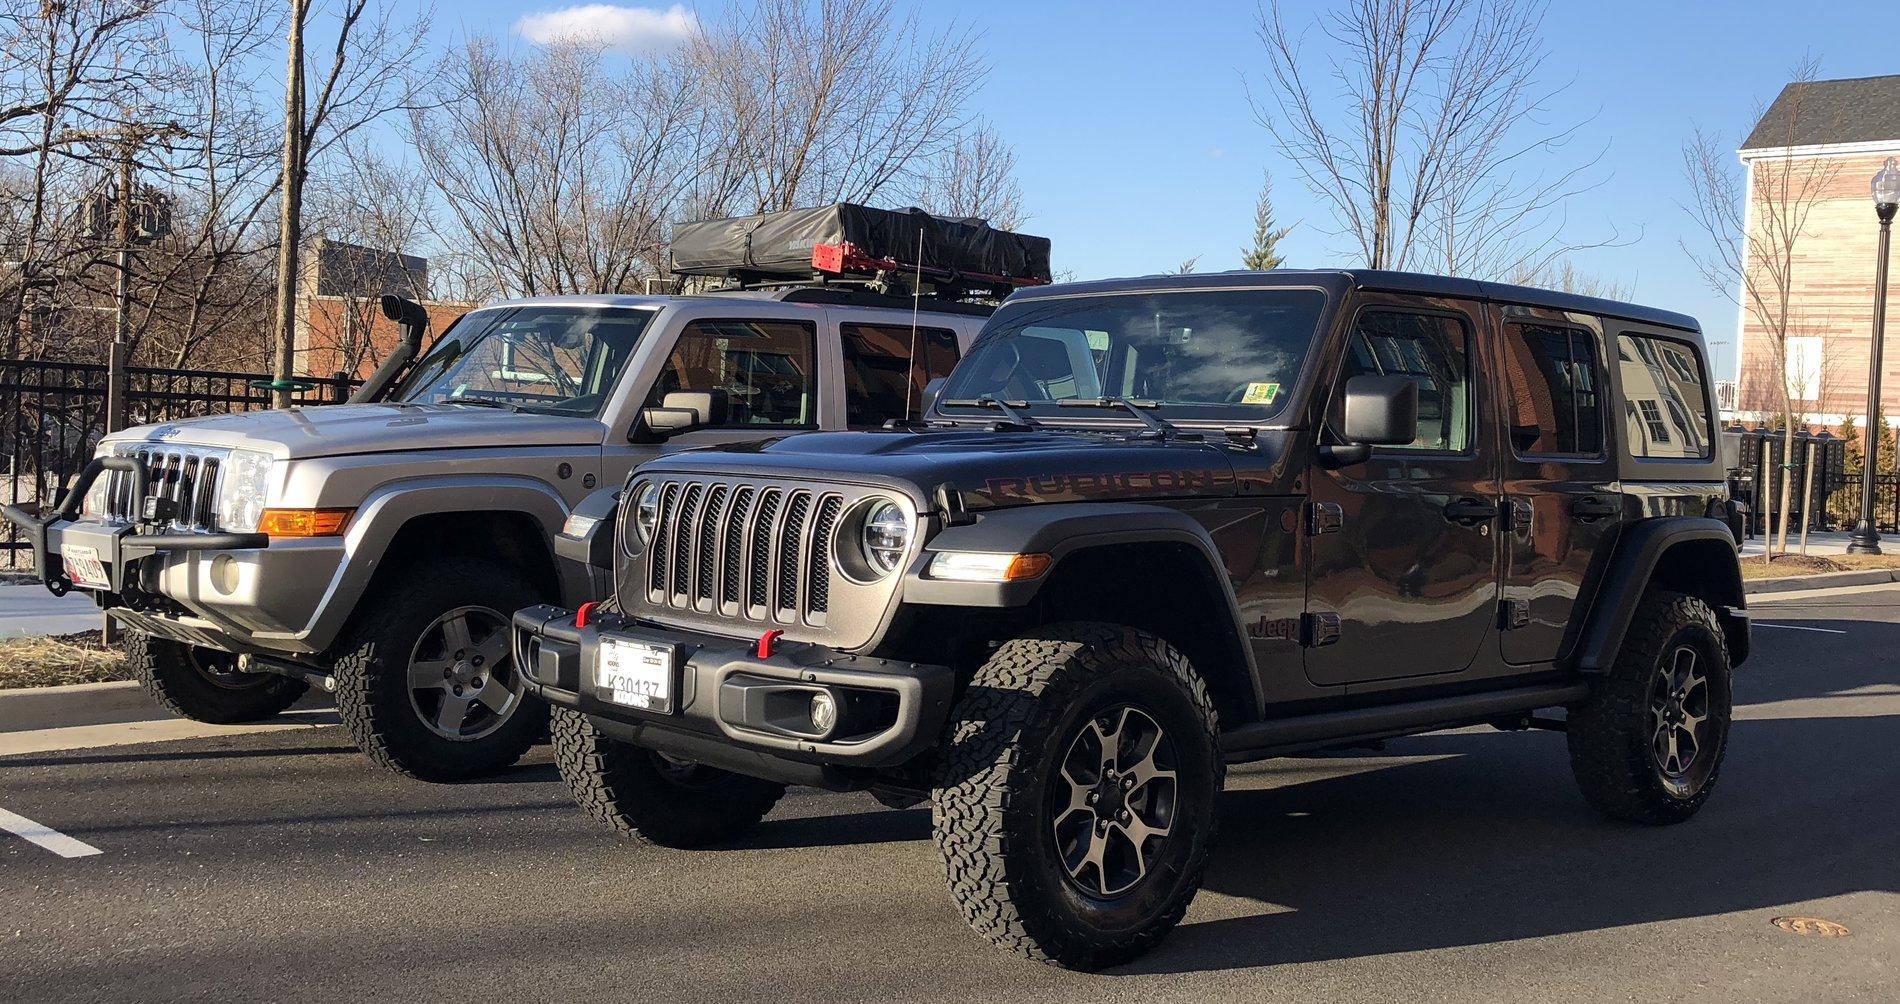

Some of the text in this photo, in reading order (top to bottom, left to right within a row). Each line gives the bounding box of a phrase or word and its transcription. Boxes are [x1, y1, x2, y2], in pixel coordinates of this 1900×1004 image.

[985, 470, 1214, 499] RUBICON
[1254, 615, 1296, 640] Jeep
[607, 673, 660, 697] K30137
